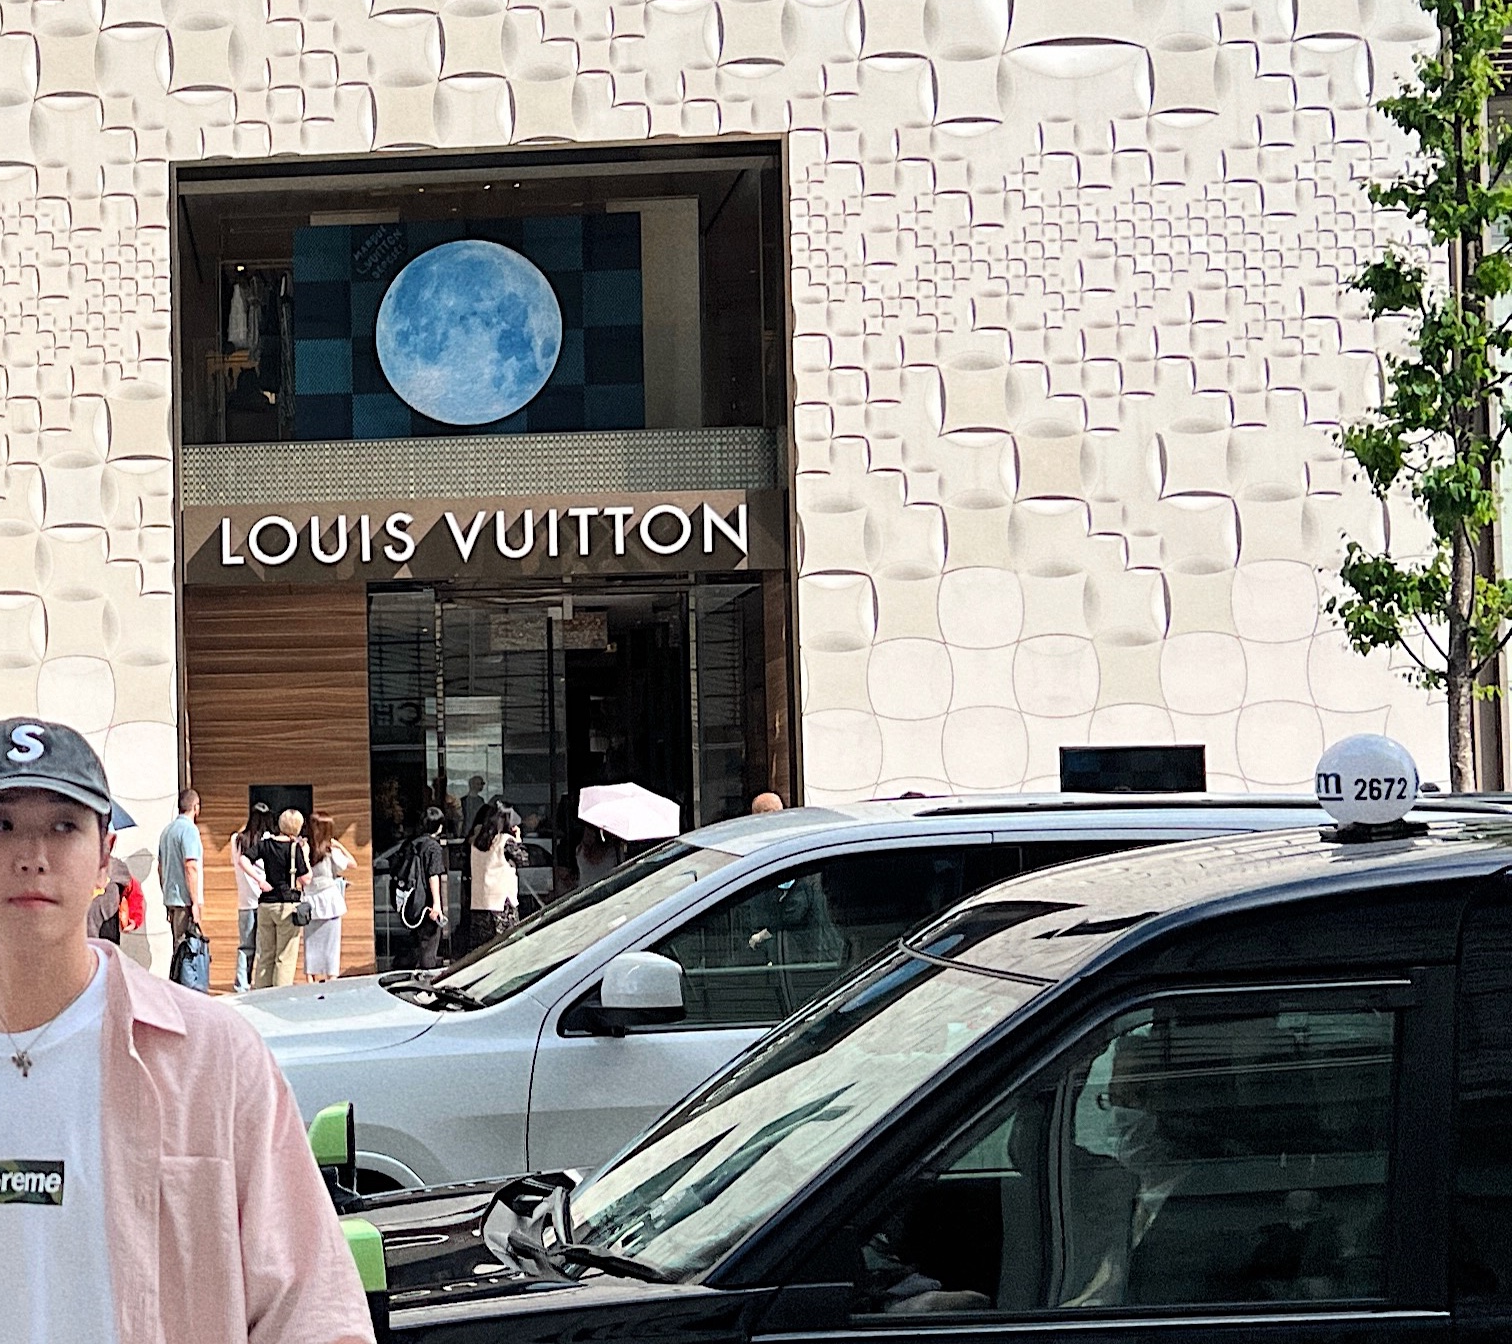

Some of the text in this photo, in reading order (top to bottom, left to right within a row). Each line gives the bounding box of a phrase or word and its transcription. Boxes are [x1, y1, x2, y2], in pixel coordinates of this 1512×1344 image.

[221, 502, 749, 565] LOUIS VUITTON
[6, 724, 45, 763] S
[1354, 777, 1408, 801] 2672
